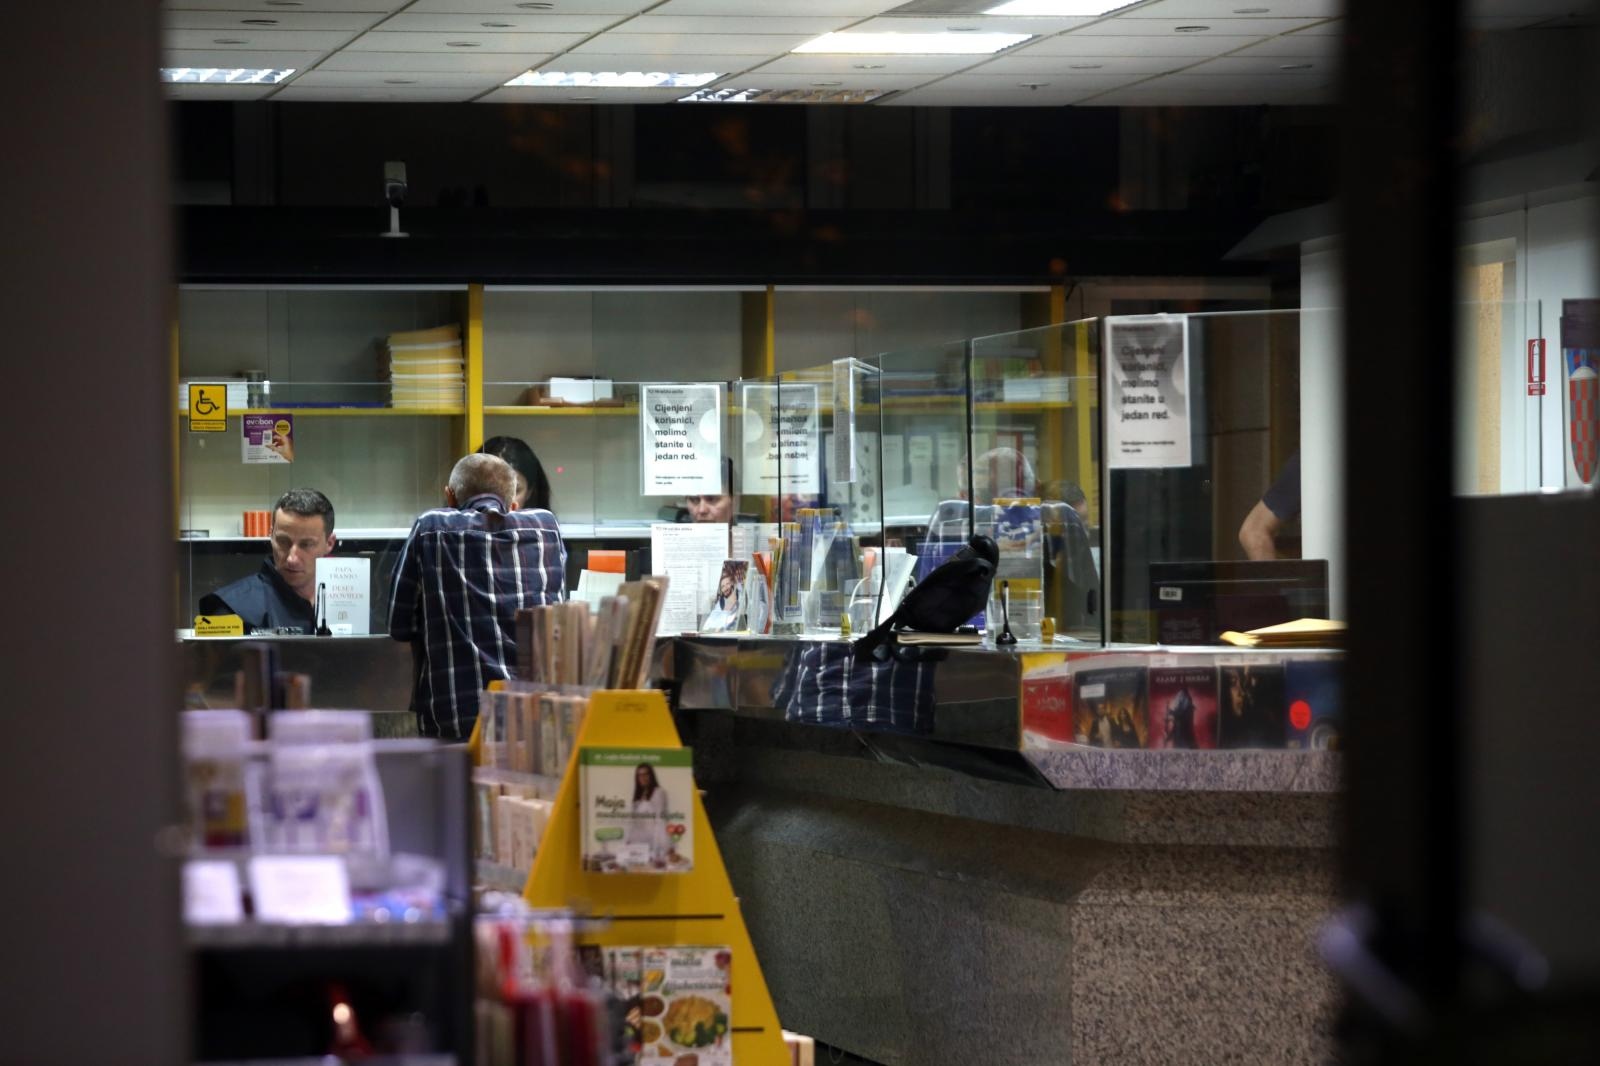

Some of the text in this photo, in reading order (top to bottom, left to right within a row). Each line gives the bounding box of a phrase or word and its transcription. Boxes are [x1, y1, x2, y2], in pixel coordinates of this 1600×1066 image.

[1121, 378, 1159, 387] molimo
[1121, 394, 1165, 404] stanite u
[655, 404, 693, 414] Cijenjeni
[1120, 409, 1169, 422] jedan red.
[655, 416, 695, 425] korisnici,
[655, 428, 687, 436] molimo
[654, 453, 679, 462] jedan
[594, 795, 626, 813] Moja
